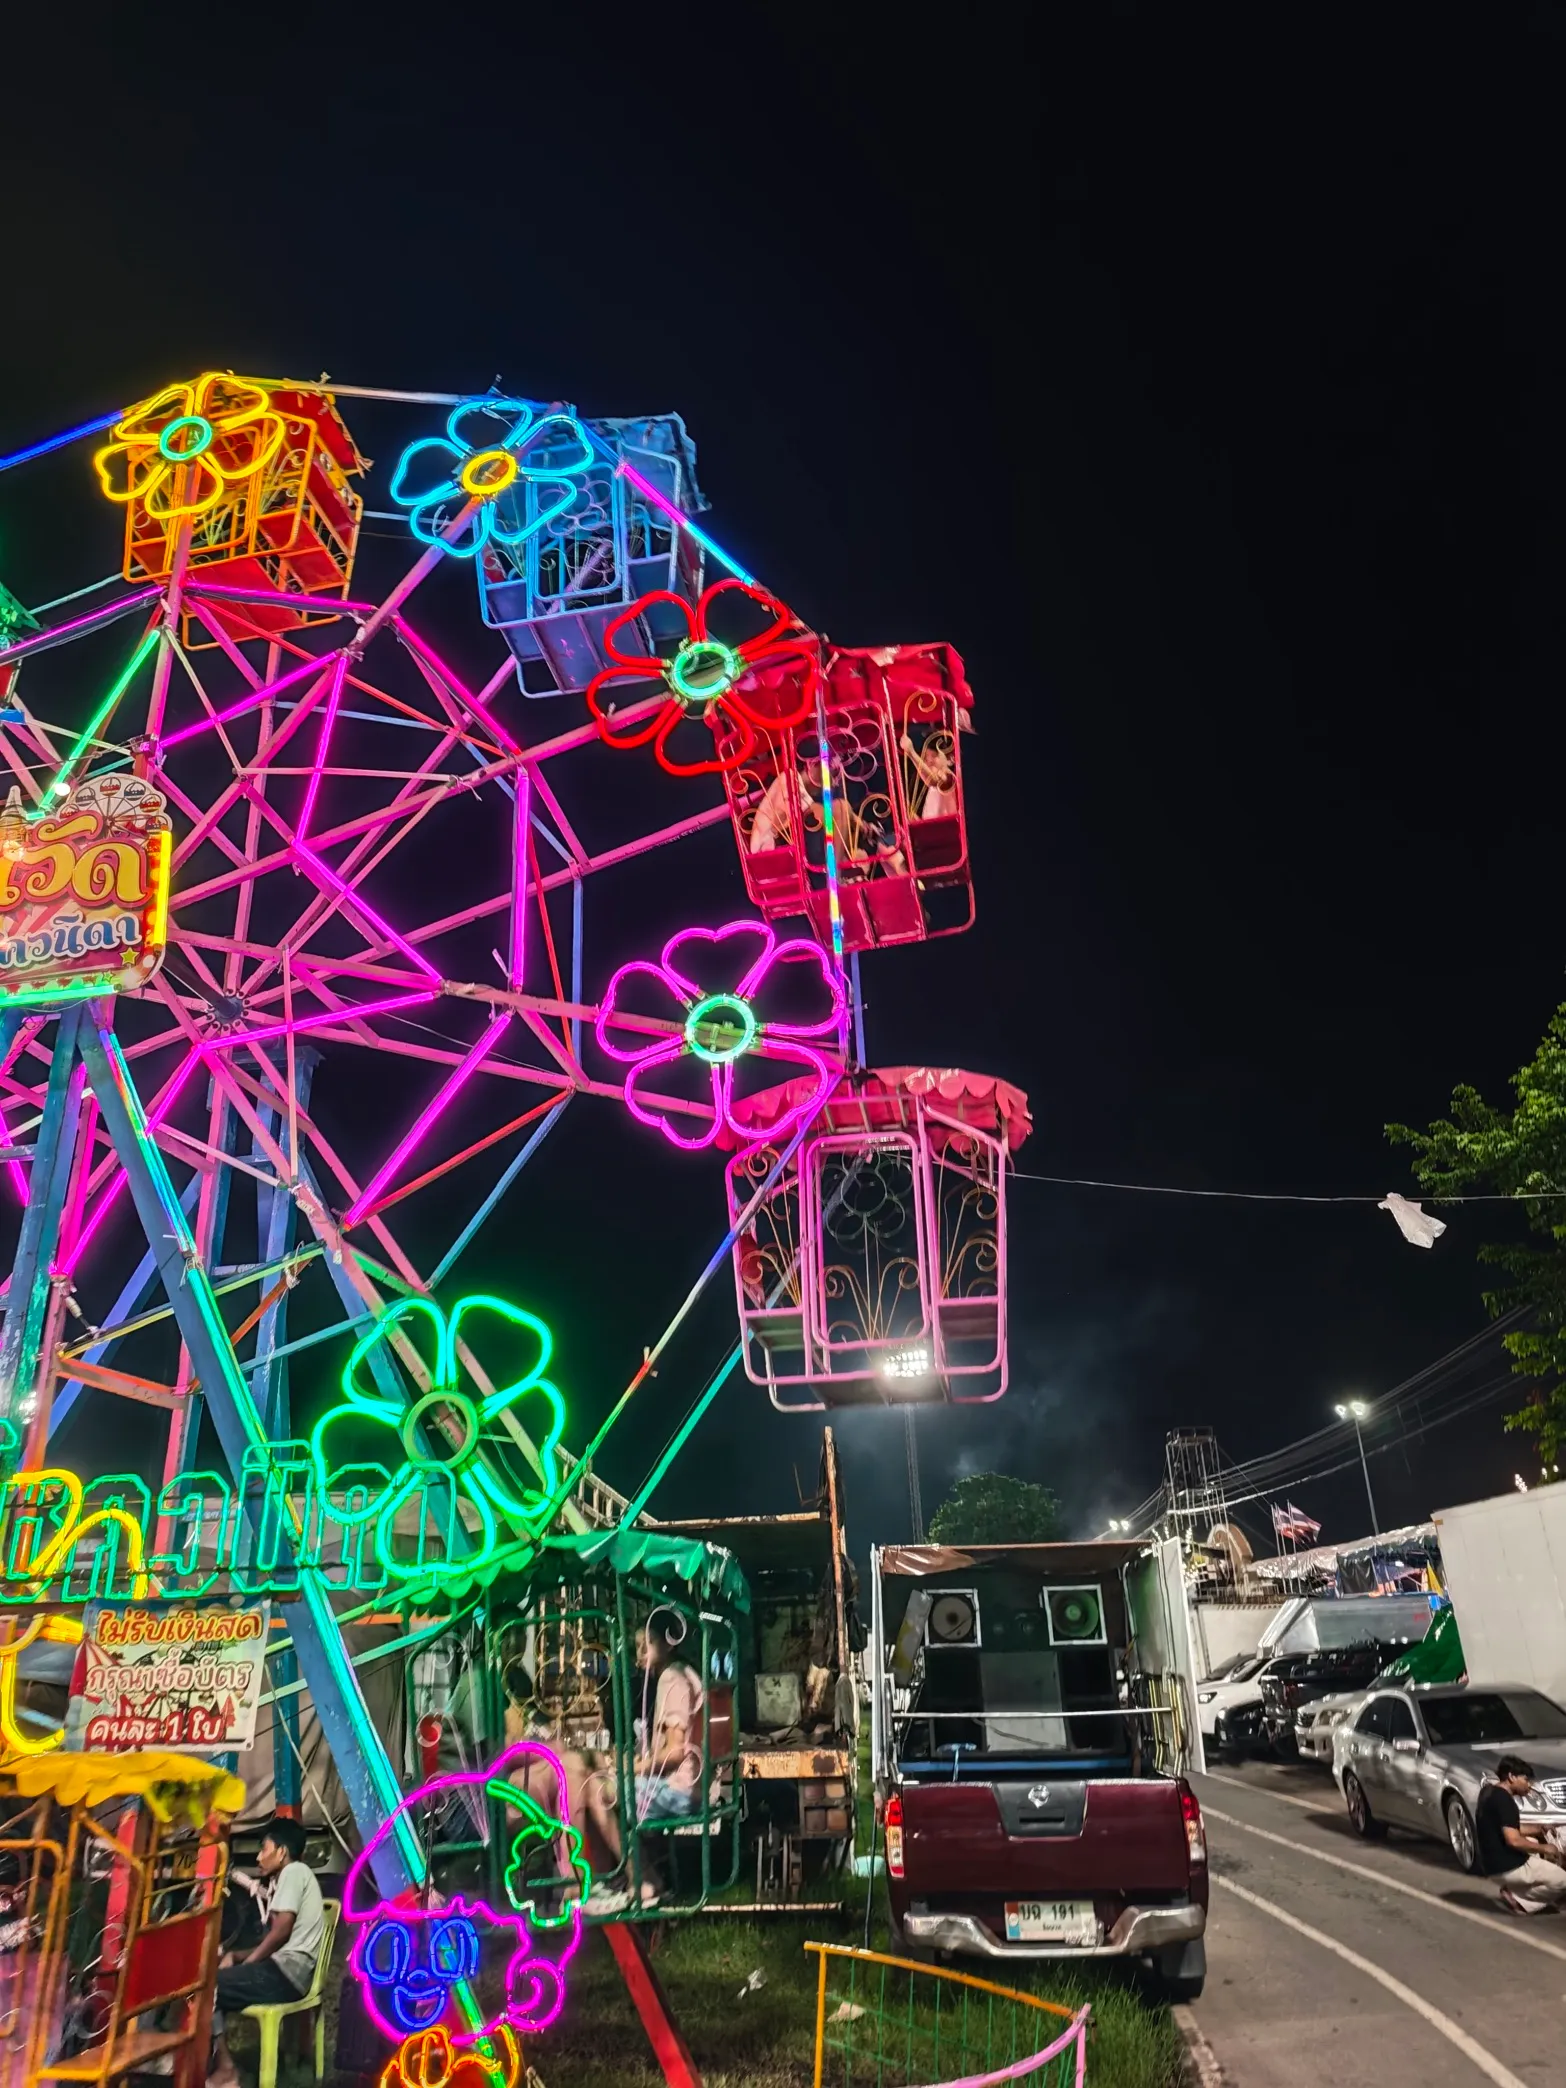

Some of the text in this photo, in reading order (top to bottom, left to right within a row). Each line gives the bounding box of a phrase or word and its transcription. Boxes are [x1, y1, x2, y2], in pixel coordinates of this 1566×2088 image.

[97, 1607, 263, 1645] ไม่รับเงินสด
[87, 1647, 253, 1700] กรุณาซื้อบัตร
[91, 1713, 221, 1742] คนละ 1 ใบ
